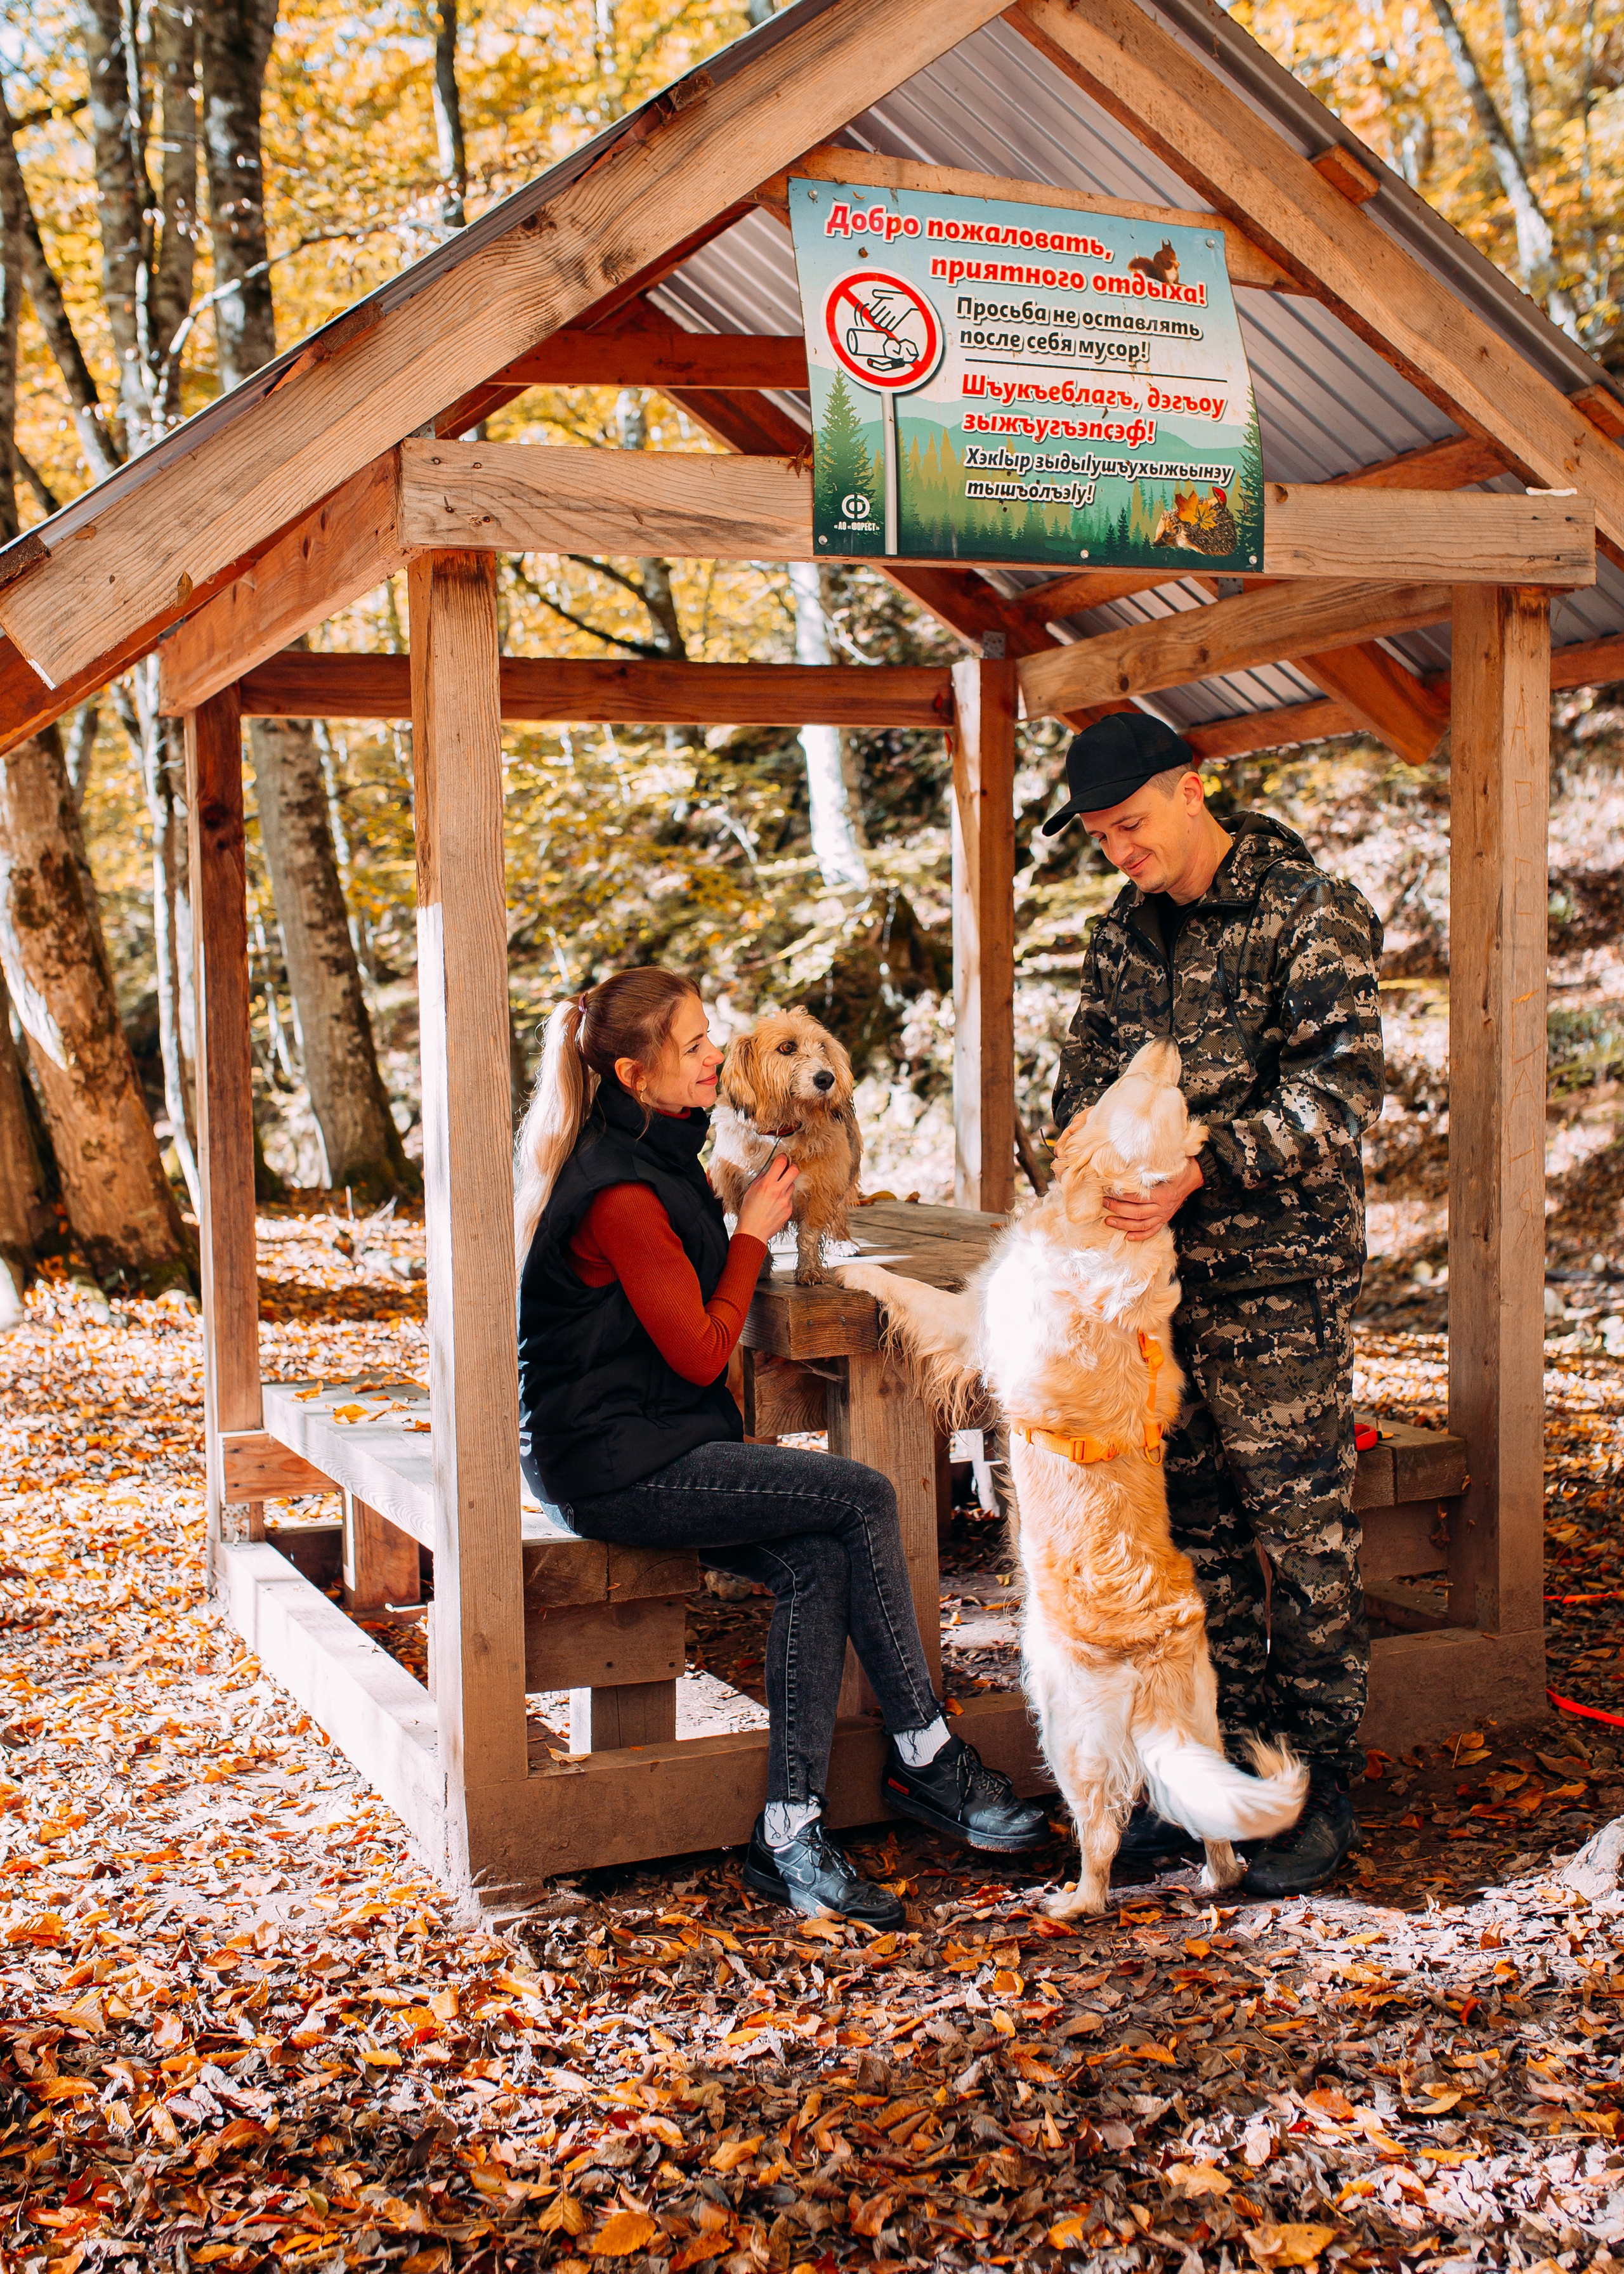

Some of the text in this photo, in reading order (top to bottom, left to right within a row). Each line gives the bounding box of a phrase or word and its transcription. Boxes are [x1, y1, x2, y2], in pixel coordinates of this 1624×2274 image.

[826, 205, 1112, 259] Добро пожаловать,
[932, 258, 1206, 304] приятного отдыха!
[957, 296, 1200, 336] Просьба не оставлять
[960, 330, 1147, 360] после себя мусор!
[962, 374, 1225, 418] Шъукъеблагъ, дэгъоу
[963, 414, 1155, 447] зыжъугъэпсэф!
